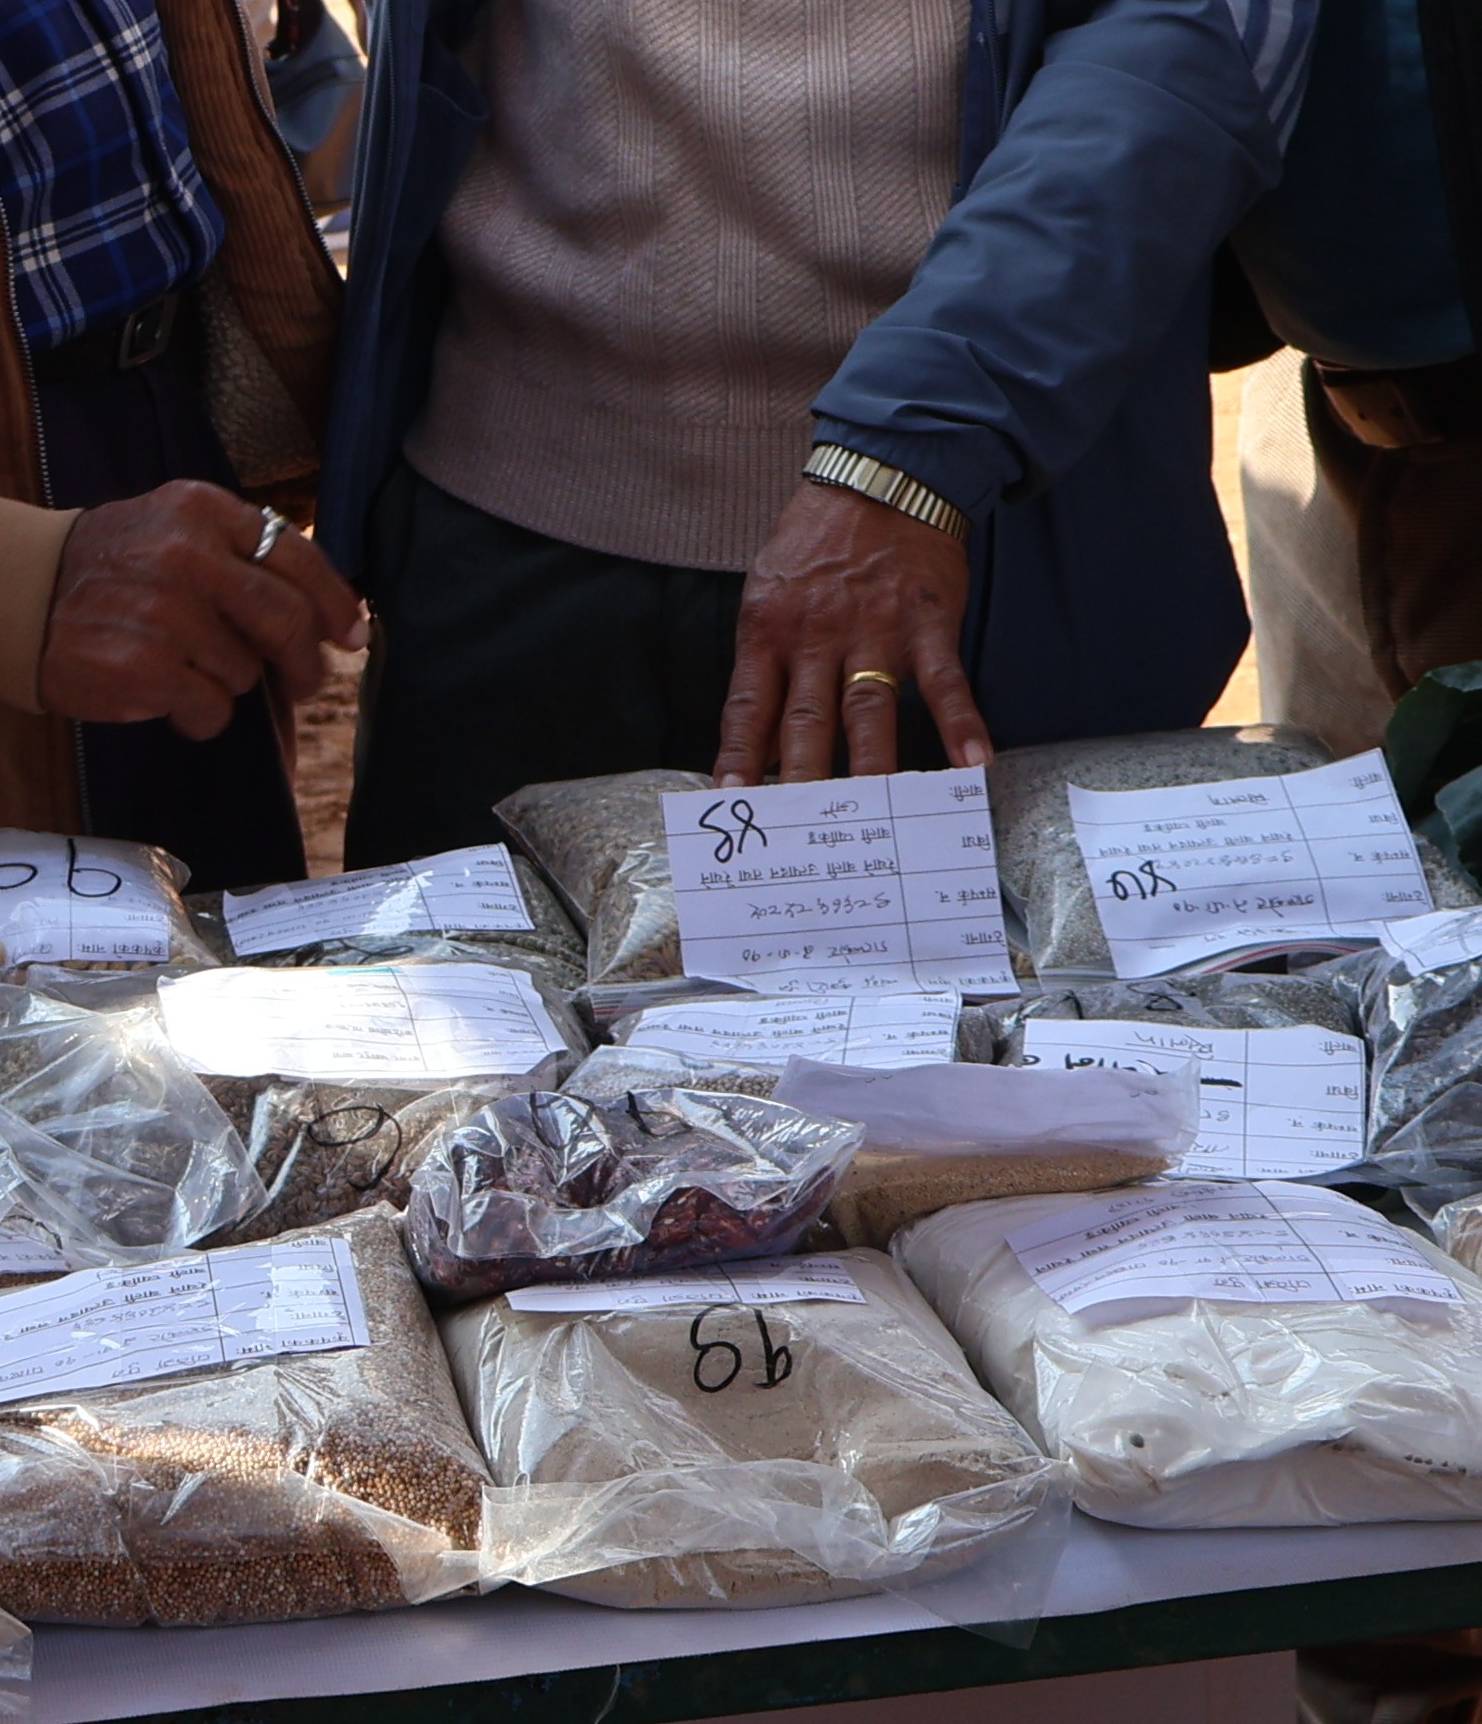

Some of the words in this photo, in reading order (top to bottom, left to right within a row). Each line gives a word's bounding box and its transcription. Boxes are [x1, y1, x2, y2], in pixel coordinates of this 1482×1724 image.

[737, 866, 762, 883] तथा
[768, 861, 818, 882] उत्पादन
[957, 886, 997, 906] सम्पर्क
[112, 938, 166, 960] कृषकको
